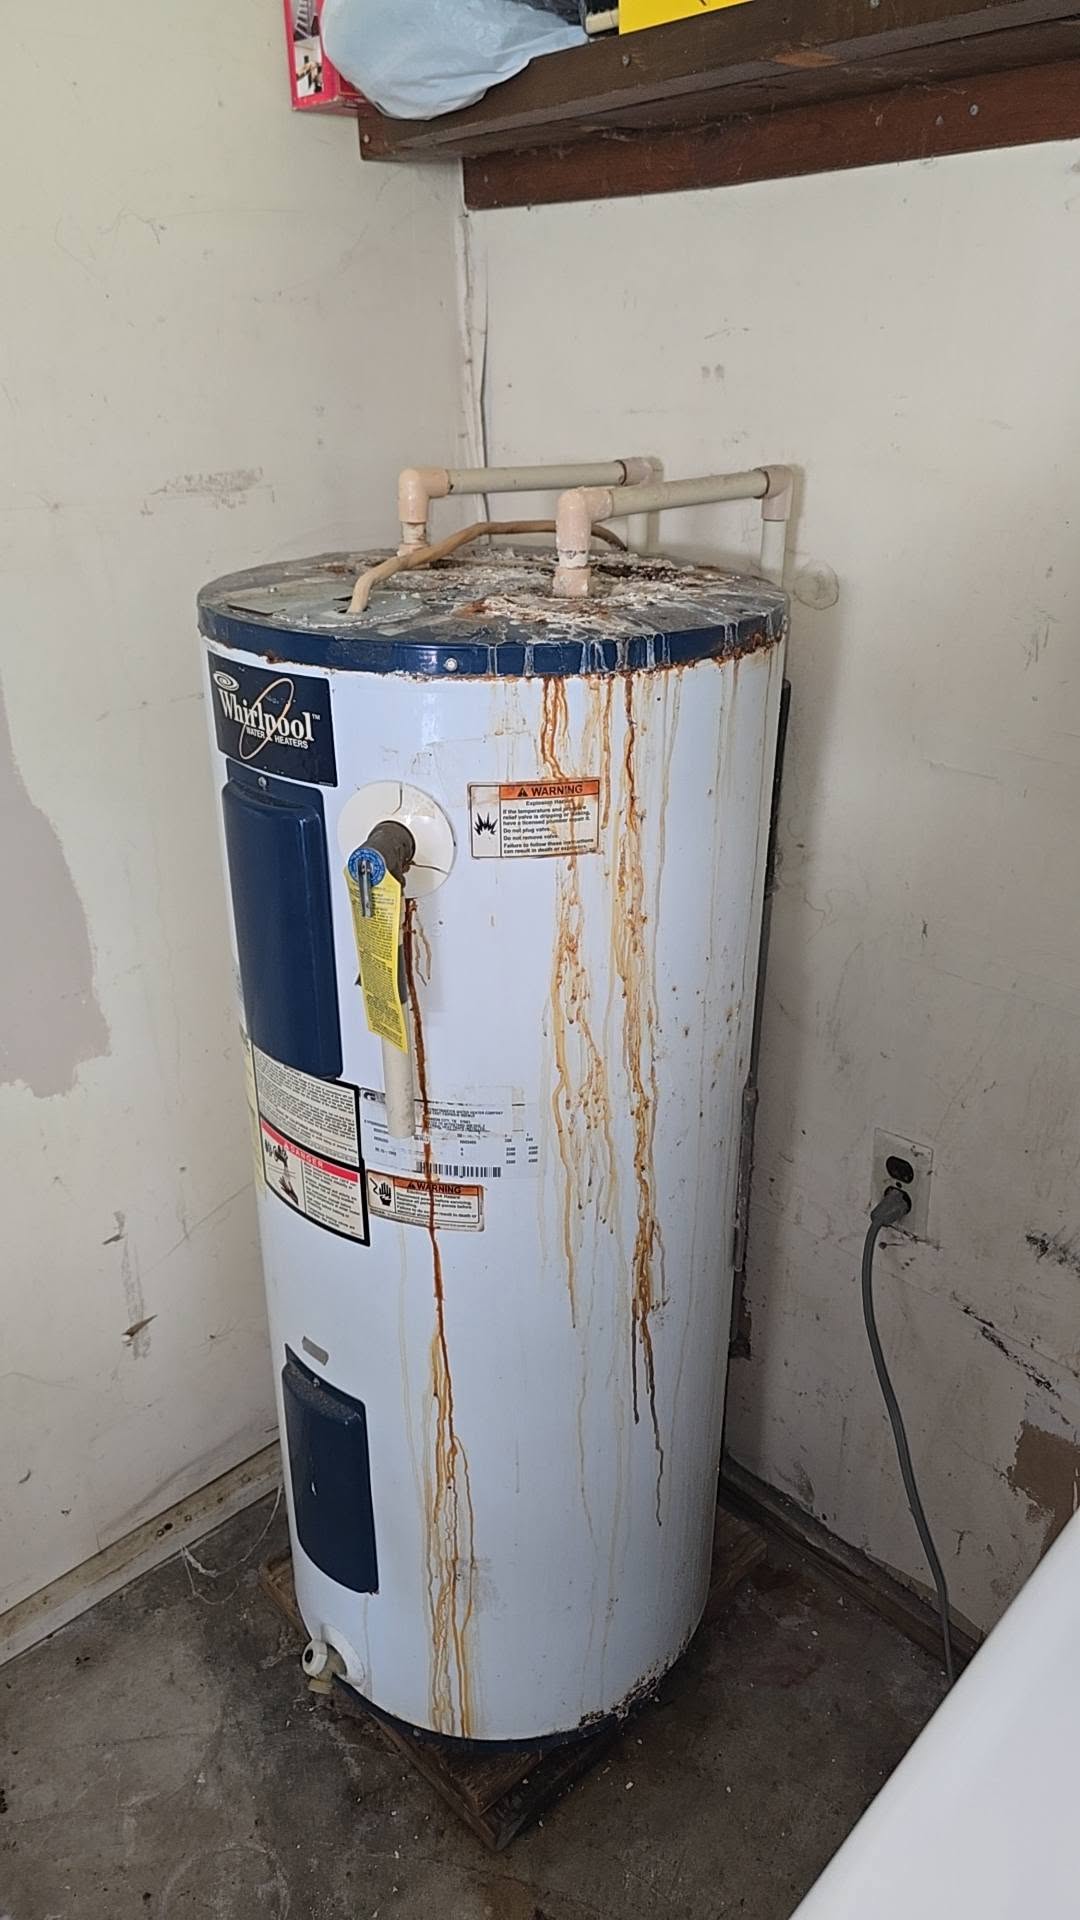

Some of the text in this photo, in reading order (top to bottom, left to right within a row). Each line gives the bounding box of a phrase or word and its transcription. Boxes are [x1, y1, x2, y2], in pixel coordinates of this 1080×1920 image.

[218, 688, 315, 742] Whirlpool
[246, 726, 308, 749] WATER HEATERS
[531, 784, 583, 797] WARNING
[290, 1146, 323, 1169] DANGER
[417, 1181, 461, 1194] WARNING
